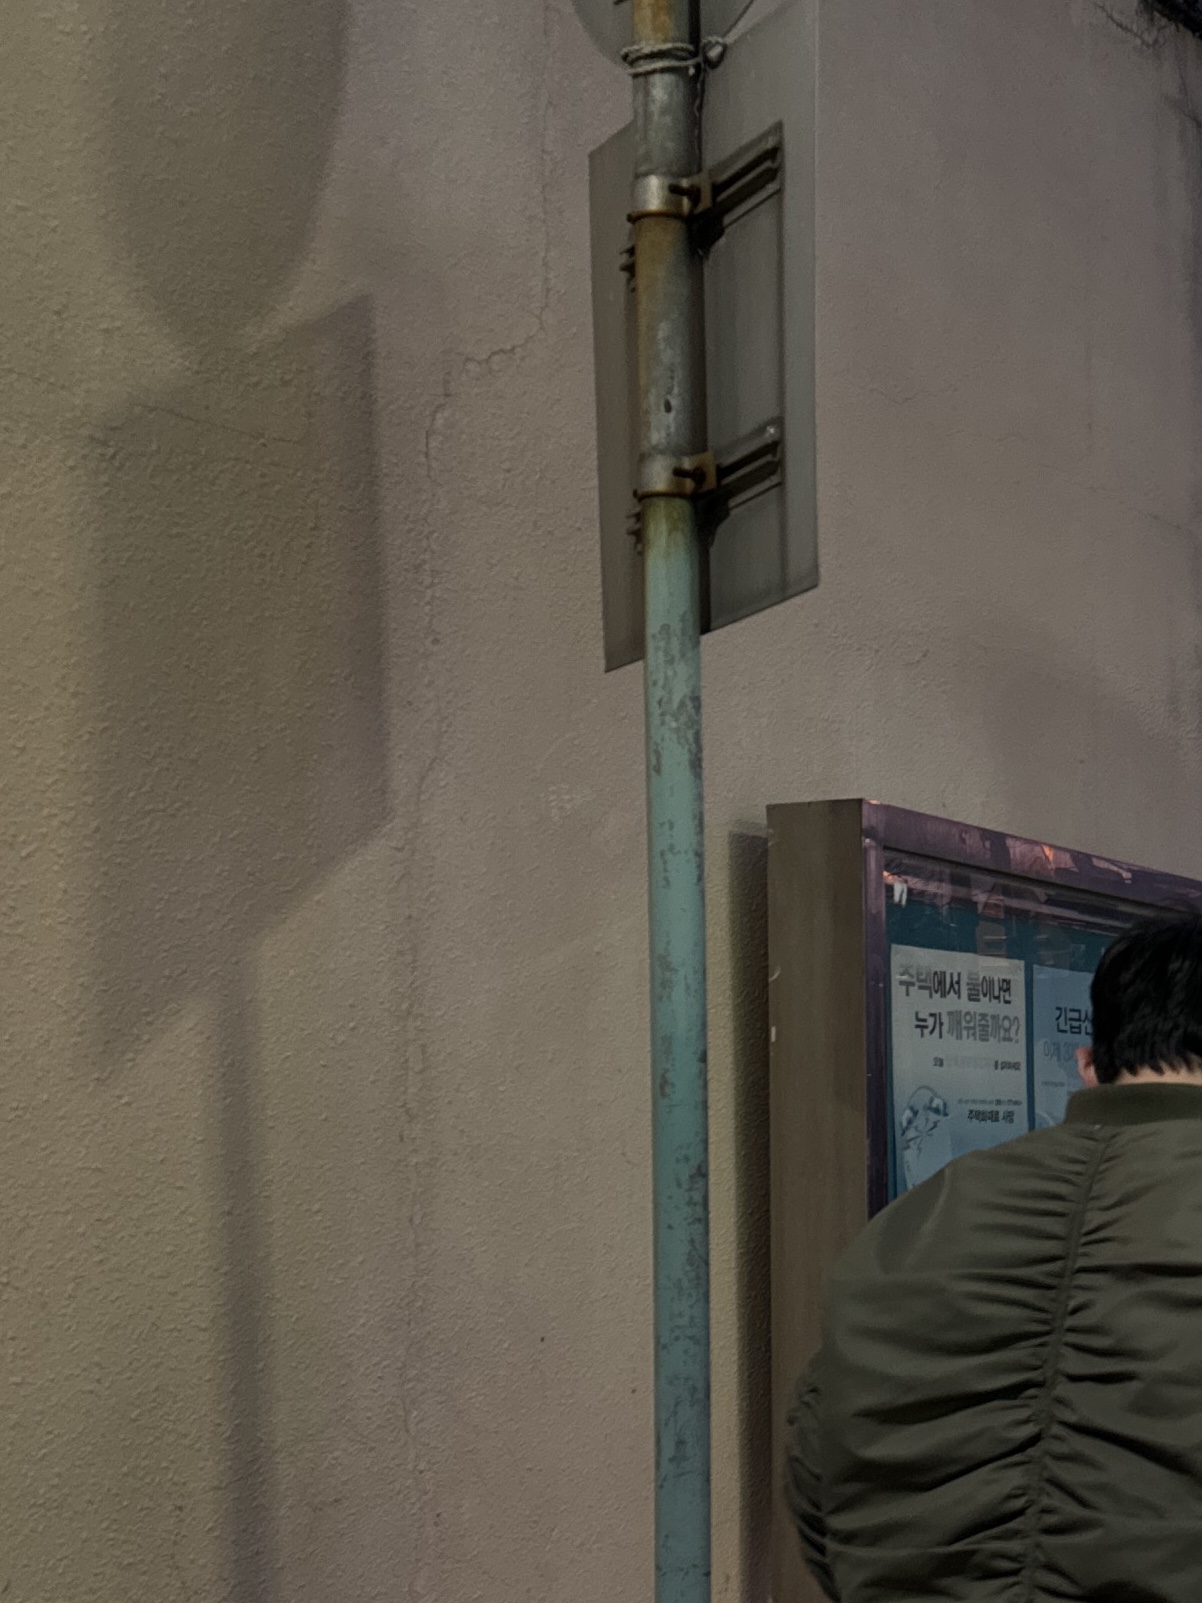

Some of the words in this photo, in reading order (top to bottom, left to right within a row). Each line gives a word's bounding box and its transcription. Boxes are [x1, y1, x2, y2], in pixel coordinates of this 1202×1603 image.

[899, 964, 961, 999] 주택에서
[915, 1012, 943, 1039] 누가
[947, 1010, 1020, 1043] 깨워줄까요?
